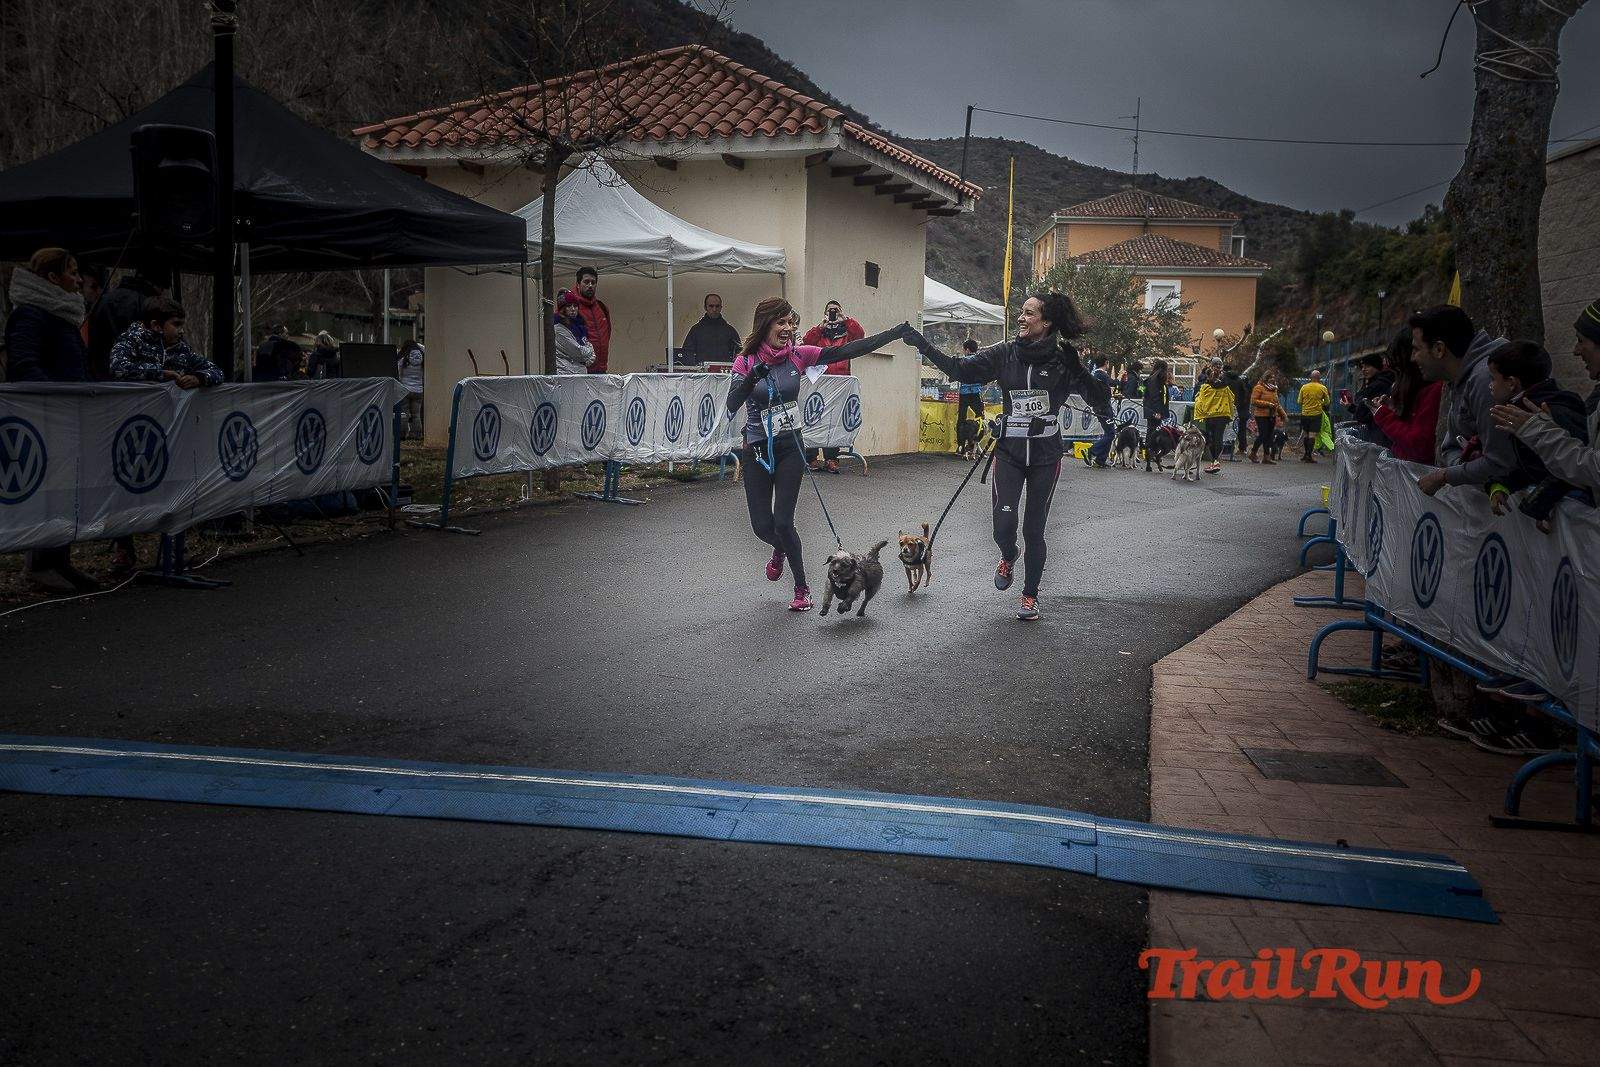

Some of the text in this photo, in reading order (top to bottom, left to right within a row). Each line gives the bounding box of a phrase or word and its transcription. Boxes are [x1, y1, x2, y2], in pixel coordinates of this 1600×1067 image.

[531, 405, 556, 453] VW
[583, 403, 605, 448] VW
[627, 400, 645, 443] VW
[666, 399, 684, 440] VW
[1025, 401, 1043, 412] 108
[115, 419, 167, 489] VW
[474, 406, 499, 458] VW
[1475, 538, 1510, 634] VW
